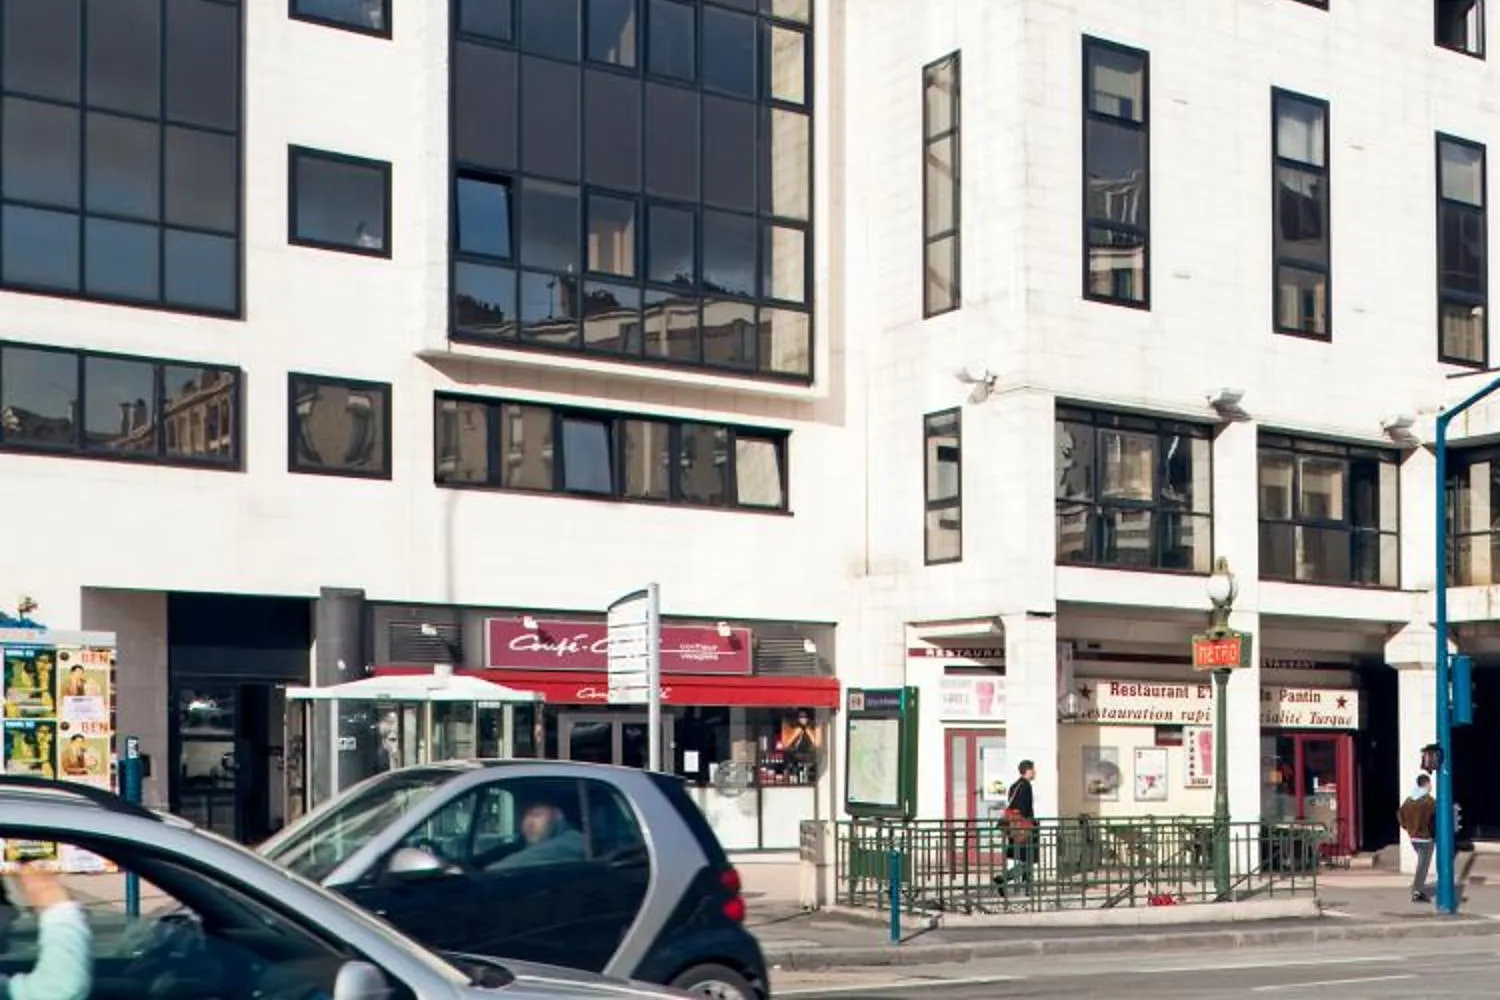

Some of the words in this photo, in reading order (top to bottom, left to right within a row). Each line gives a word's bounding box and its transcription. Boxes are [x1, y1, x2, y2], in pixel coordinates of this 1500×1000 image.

[925, 647, 1002, 658] RESTAURA
[1110, 681, 1189, 699] Restaurant
[1081, 704, 1173, 721] estauration
[1181, 706, 1211, 722] rapi
